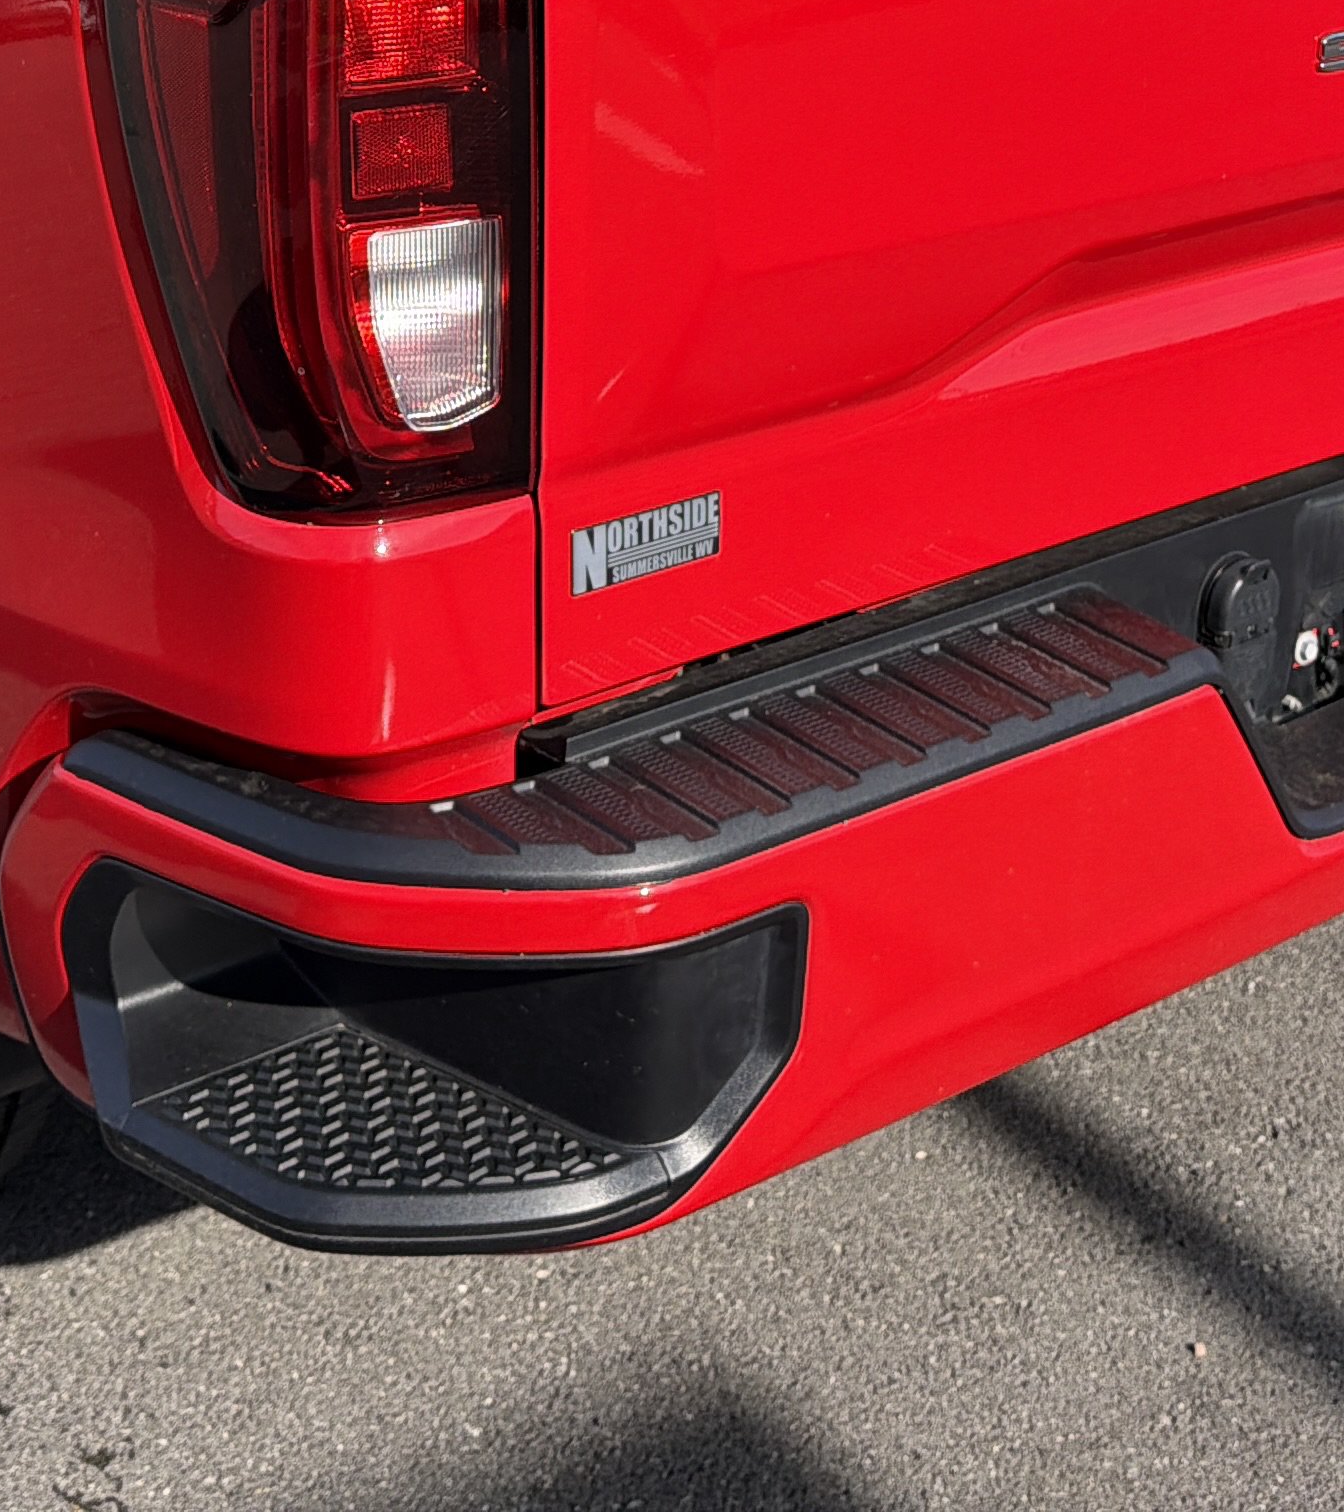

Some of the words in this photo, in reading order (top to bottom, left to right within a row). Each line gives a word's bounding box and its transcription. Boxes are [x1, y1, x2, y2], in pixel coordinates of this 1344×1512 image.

[572, 492, 719, 596] NORTHSIDE
[612, 543, 694, 584] SUMMERSVILLE
[694, 538, 715, 558] WV
